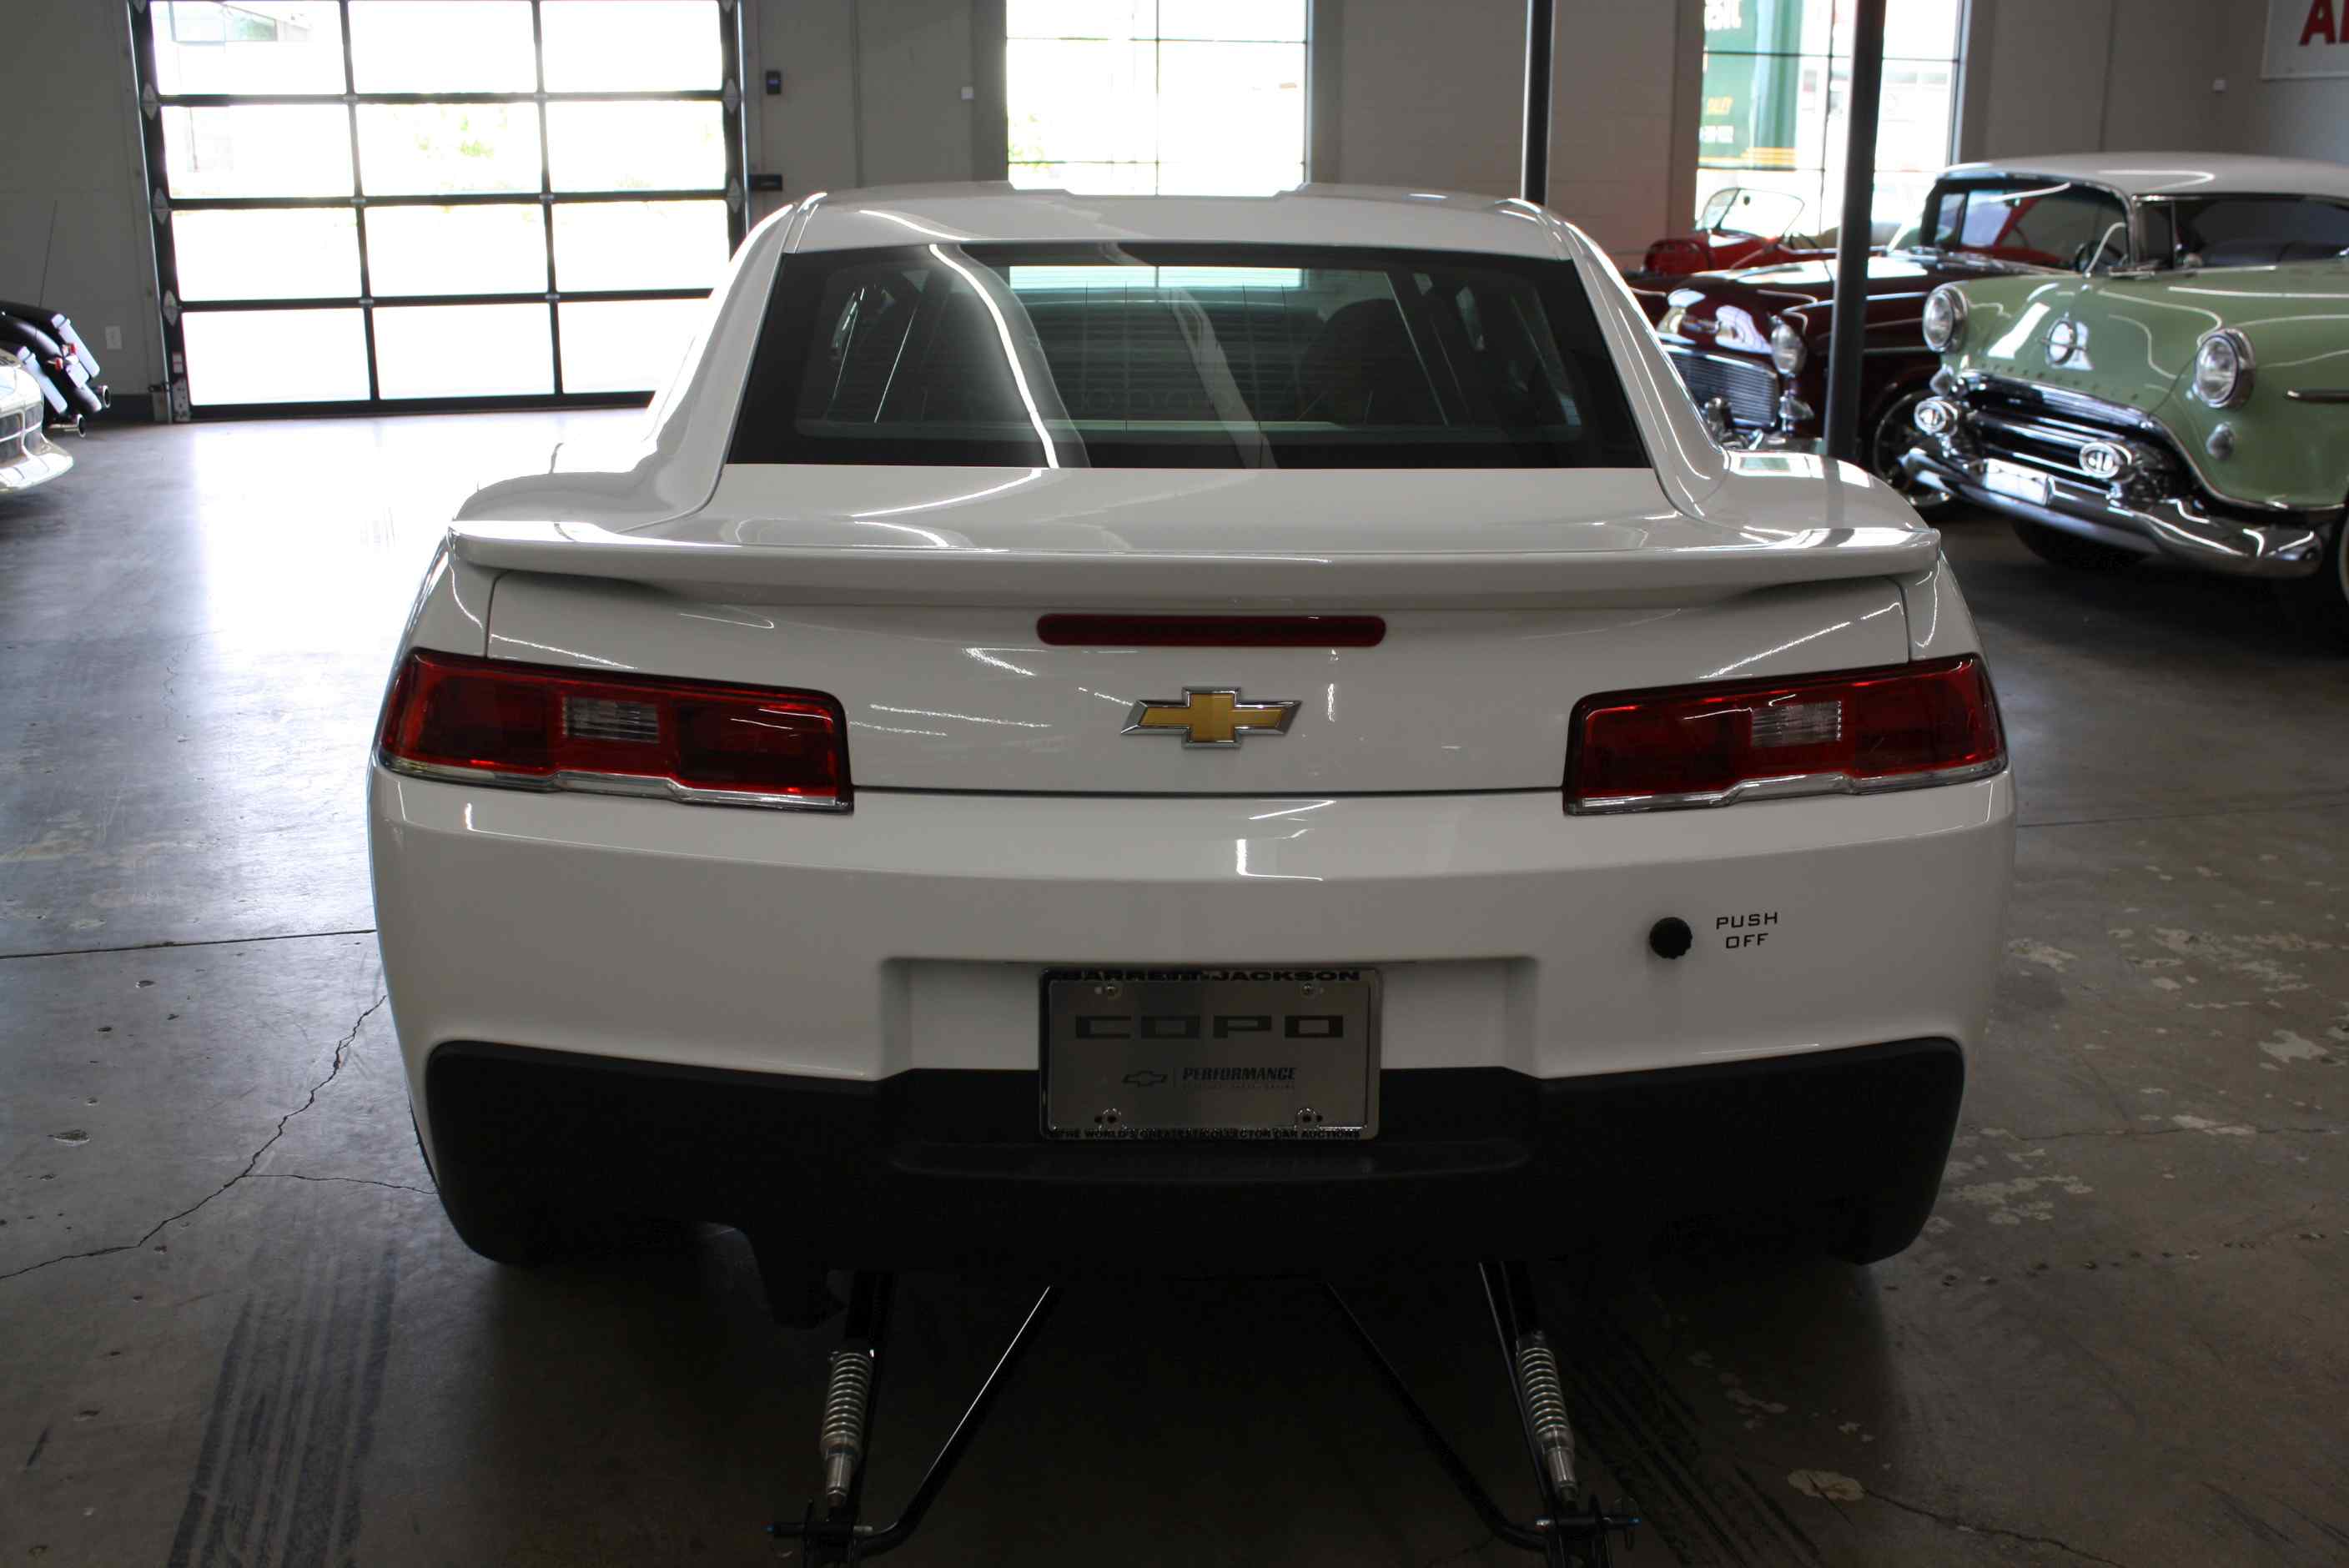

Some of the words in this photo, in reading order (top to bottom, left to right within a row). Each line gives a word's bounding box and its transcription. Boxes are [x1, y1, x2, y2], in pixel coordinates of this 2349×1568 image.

[1716, 912, 1778, 930] PUSH
[1725, 932, 1768, 949] OFF
[1075, 1015, 1344, 1039] COPO
[1182, 1067, 1297, 1081] PERFORMANCE
